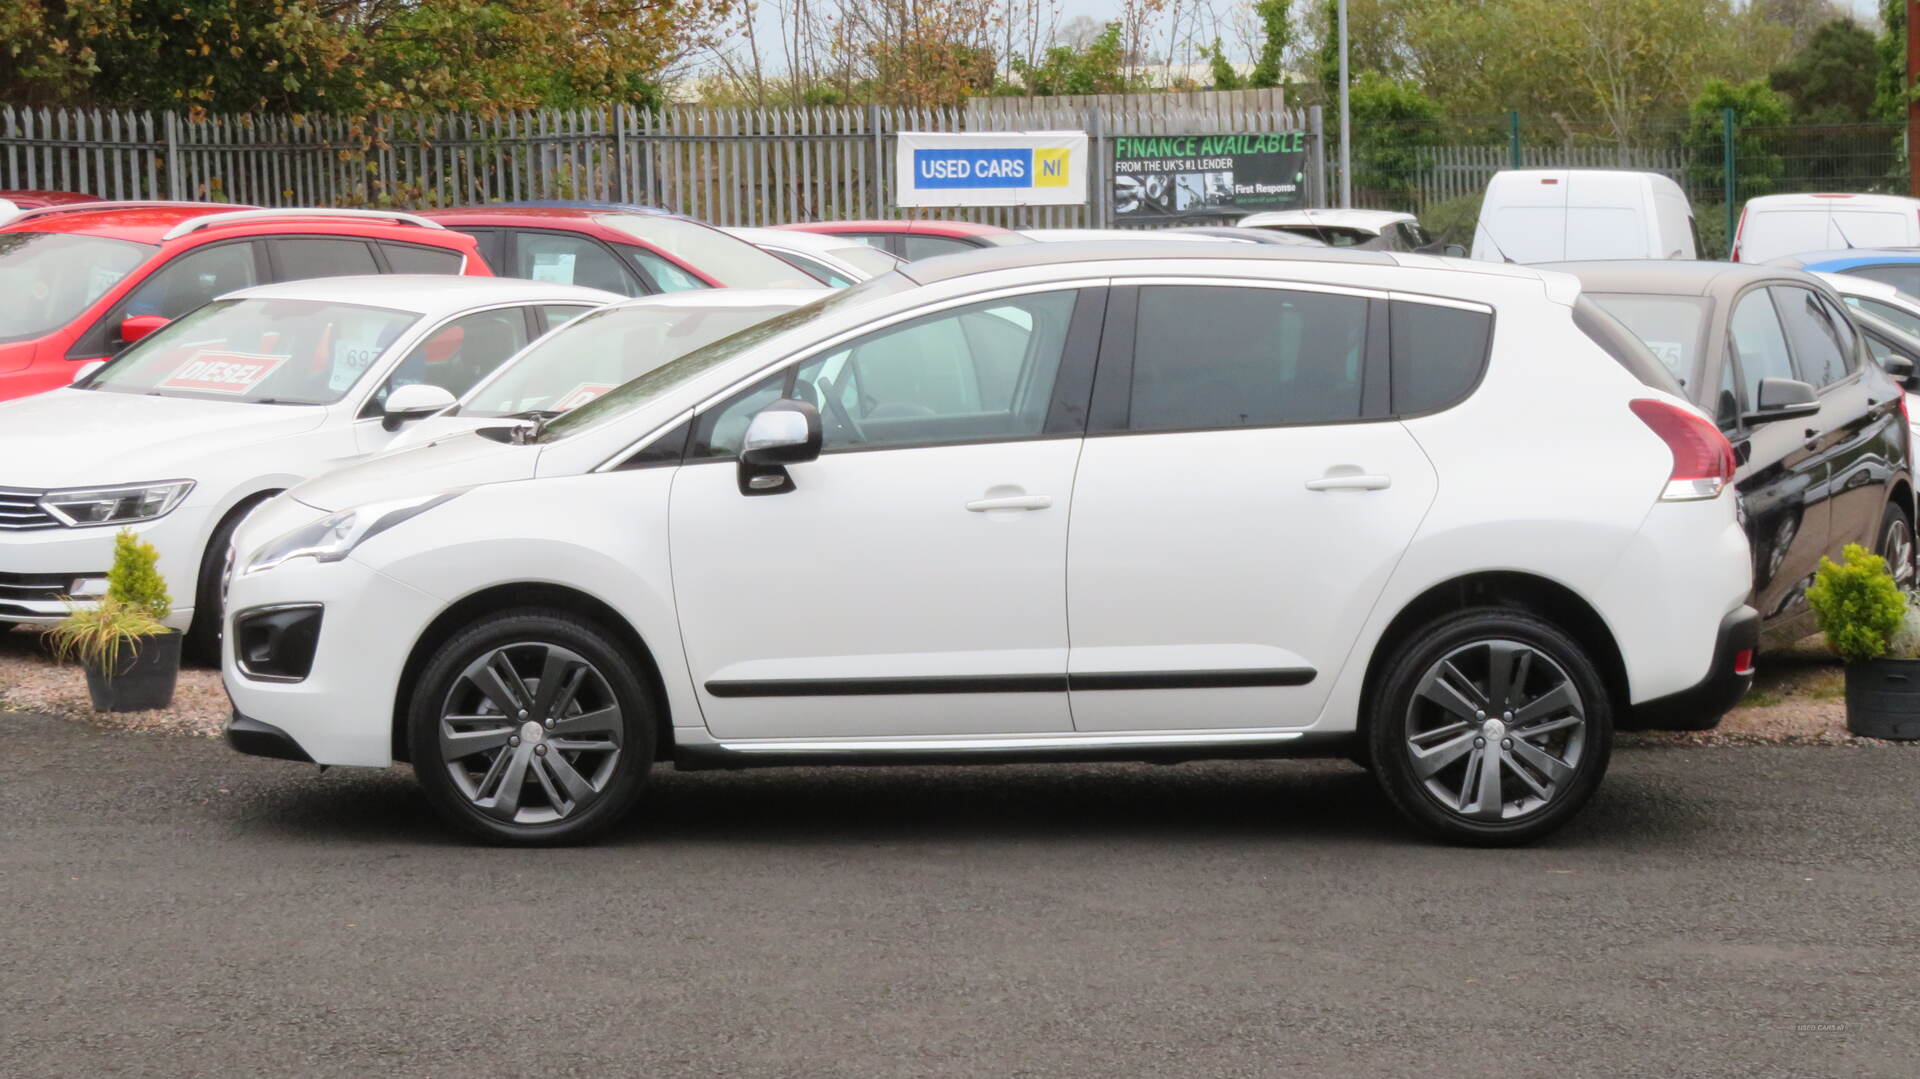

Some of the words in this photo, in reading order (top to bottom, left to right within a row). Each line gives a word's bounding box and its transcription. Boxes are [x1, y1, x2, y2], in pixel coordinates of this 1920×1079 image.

[1115, 137, 1198, 158] FINANCE
[1200, 132, 1305, 156] AVAILABLE
[921, 159, 971, 178] USED
[975, 159, 1025, 178] CARS
[1043, 159, 1061, 177] NI
[1115, 160, 1142, 172] FROM
[1144, 160, 1161, 171] THE
[1163, 159, 1185, 171] UK'S
[1186, 159, 1196, 170] #1
[1198, 158, 1233, 170] LENDER
[1235, 184, 1254, 194] First
[1256, 183, 1297, 194] Response
[175, 361, 263, 384] DIESEL
